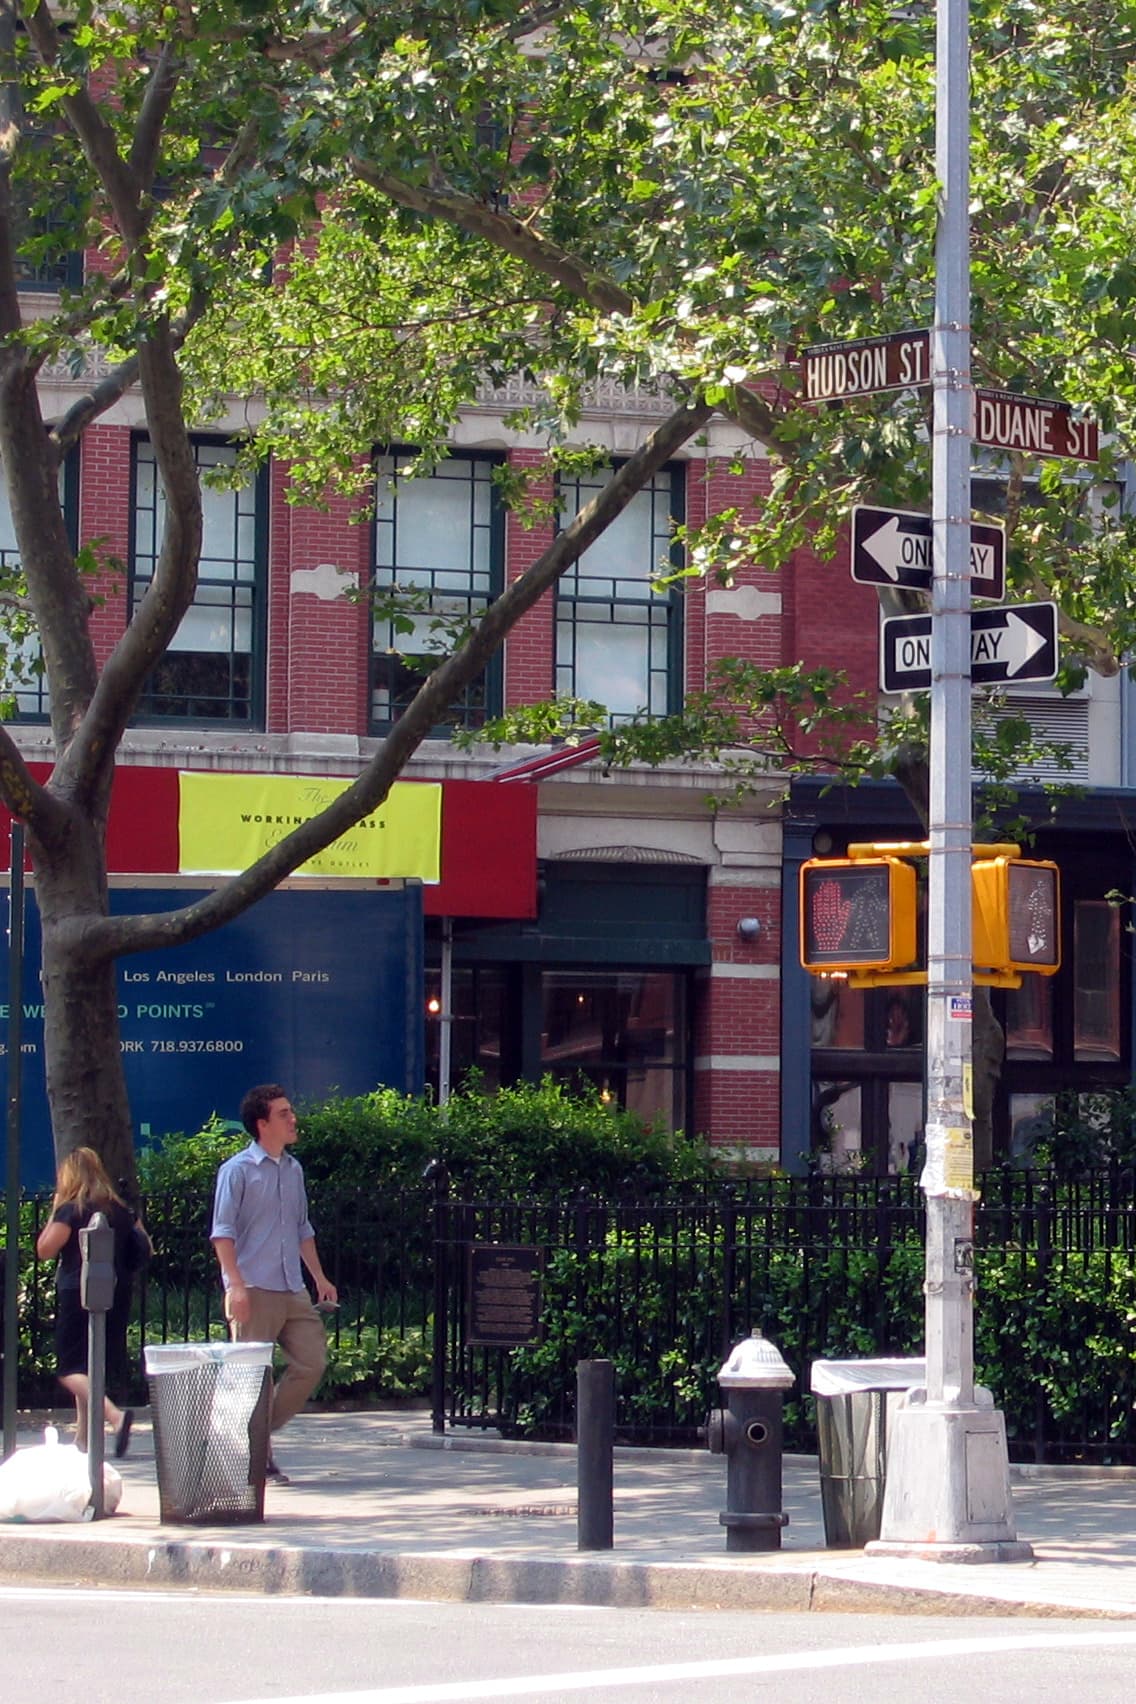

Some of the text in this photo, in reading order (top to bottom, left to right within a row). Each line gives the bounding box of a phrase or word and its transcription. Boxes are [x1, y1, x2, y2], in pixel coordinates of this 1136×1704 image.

[807, 346, 887, 399] HUDSON
[900, 340, 924, 384] ST
[980, 400, 1093, 457] DUANE ST
[902, 632, 1003, 668] ON AY
[124, 970, 330, 985] Los Angeles London Paris
[137, 1004, 204, 1018] POINTS
[151, 1040, 244, 1053] 718.937.6800
